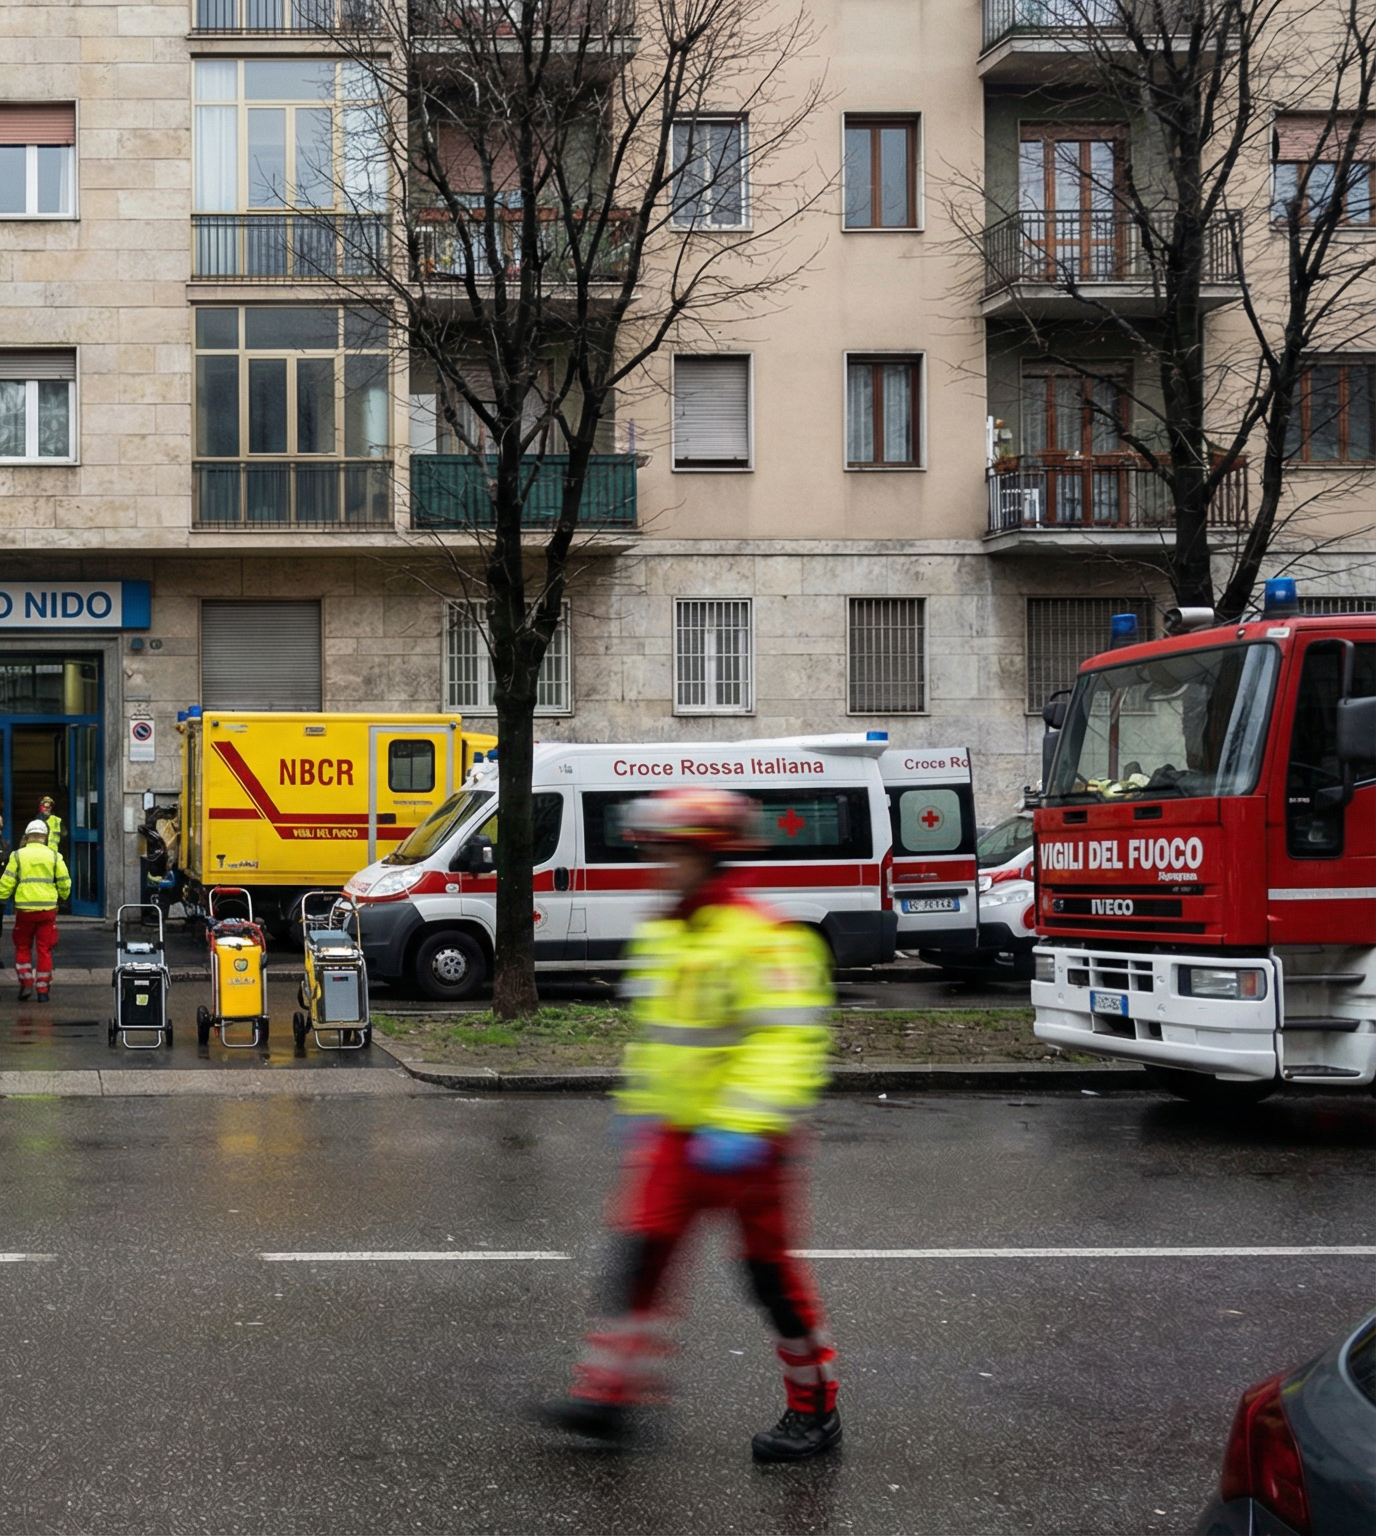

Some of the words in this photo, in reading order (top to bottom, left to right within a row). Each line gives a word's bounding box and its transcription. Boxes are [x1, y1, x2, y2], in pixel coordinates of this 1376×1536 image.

[24, 591, 113, 619] NIDO
[279, 758, 354, 786] NBCR
[613, 759, 674, 777] Croce
[680, 759, 745, 776] Rossa
[750, 757, 824, 775] Italiana
[904, 758, 946, 770] Croce
[1040, 841, 1084, 870] VIGILI
[1088, 840, 1123, 870] DEL
[1128, 836, 1204, 870] FUOCO
[1091, 899, 1134, 916] IVECO
